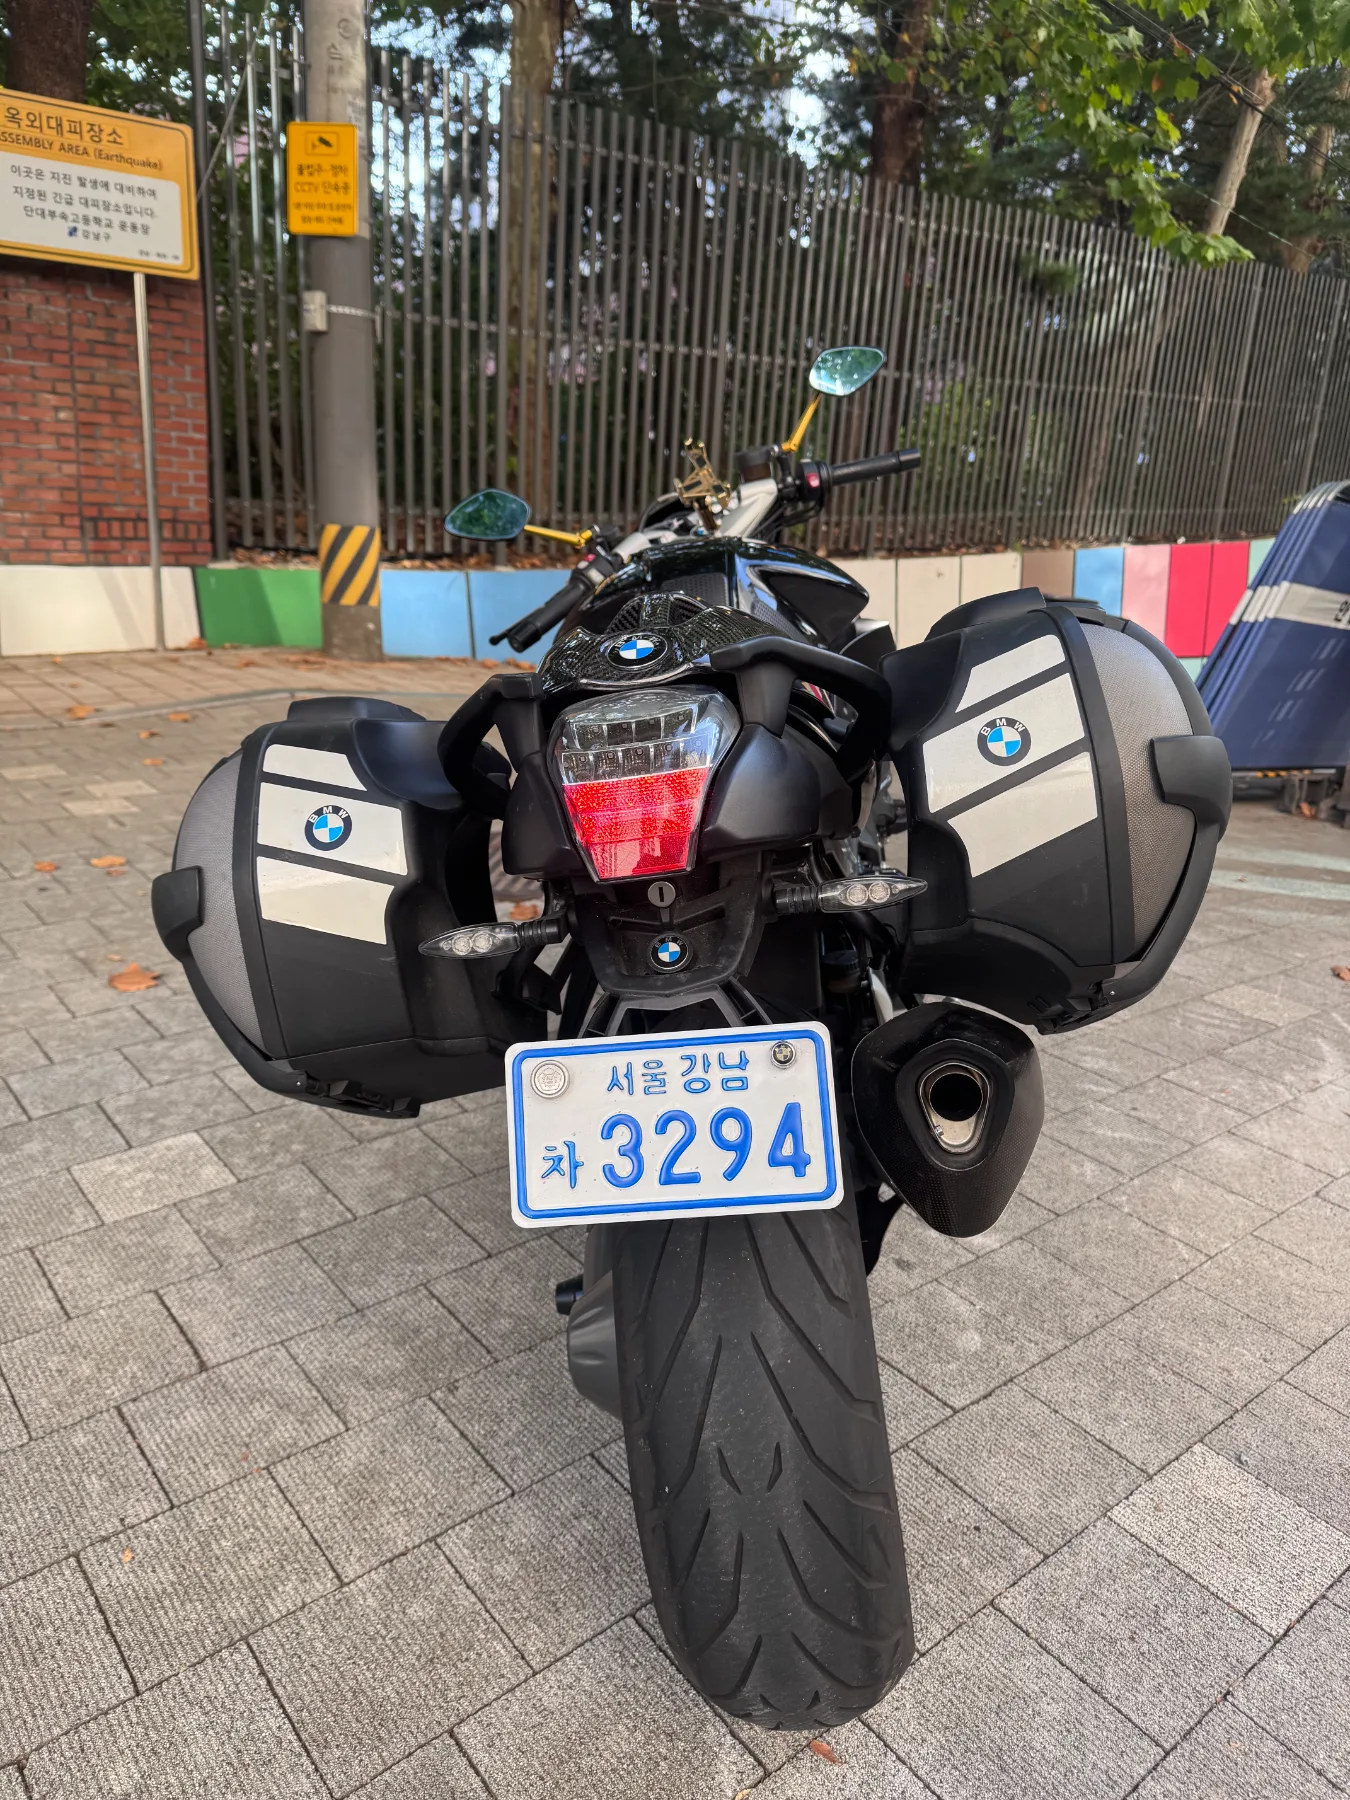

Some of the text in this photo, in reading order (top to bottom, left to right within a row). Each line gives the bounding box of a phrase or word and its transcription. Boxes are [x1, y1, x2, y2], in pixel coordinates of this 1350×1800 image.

[4, 106, 125, 146] 옥외대피장소
[0, 131, 163, 171] SSEMBLY AREA (Earthquake)
[10, 164, 157, 200] 이곳은 지진 발생에 대비하여
[12, 185, 47, 202] 지정된
[52, 191, 74, 206] 긴급
[980, 717, 1026, 736] BMW
[308, 805, 349, 823] BMW
[541, 1102, 811, 1189] 차 3294
